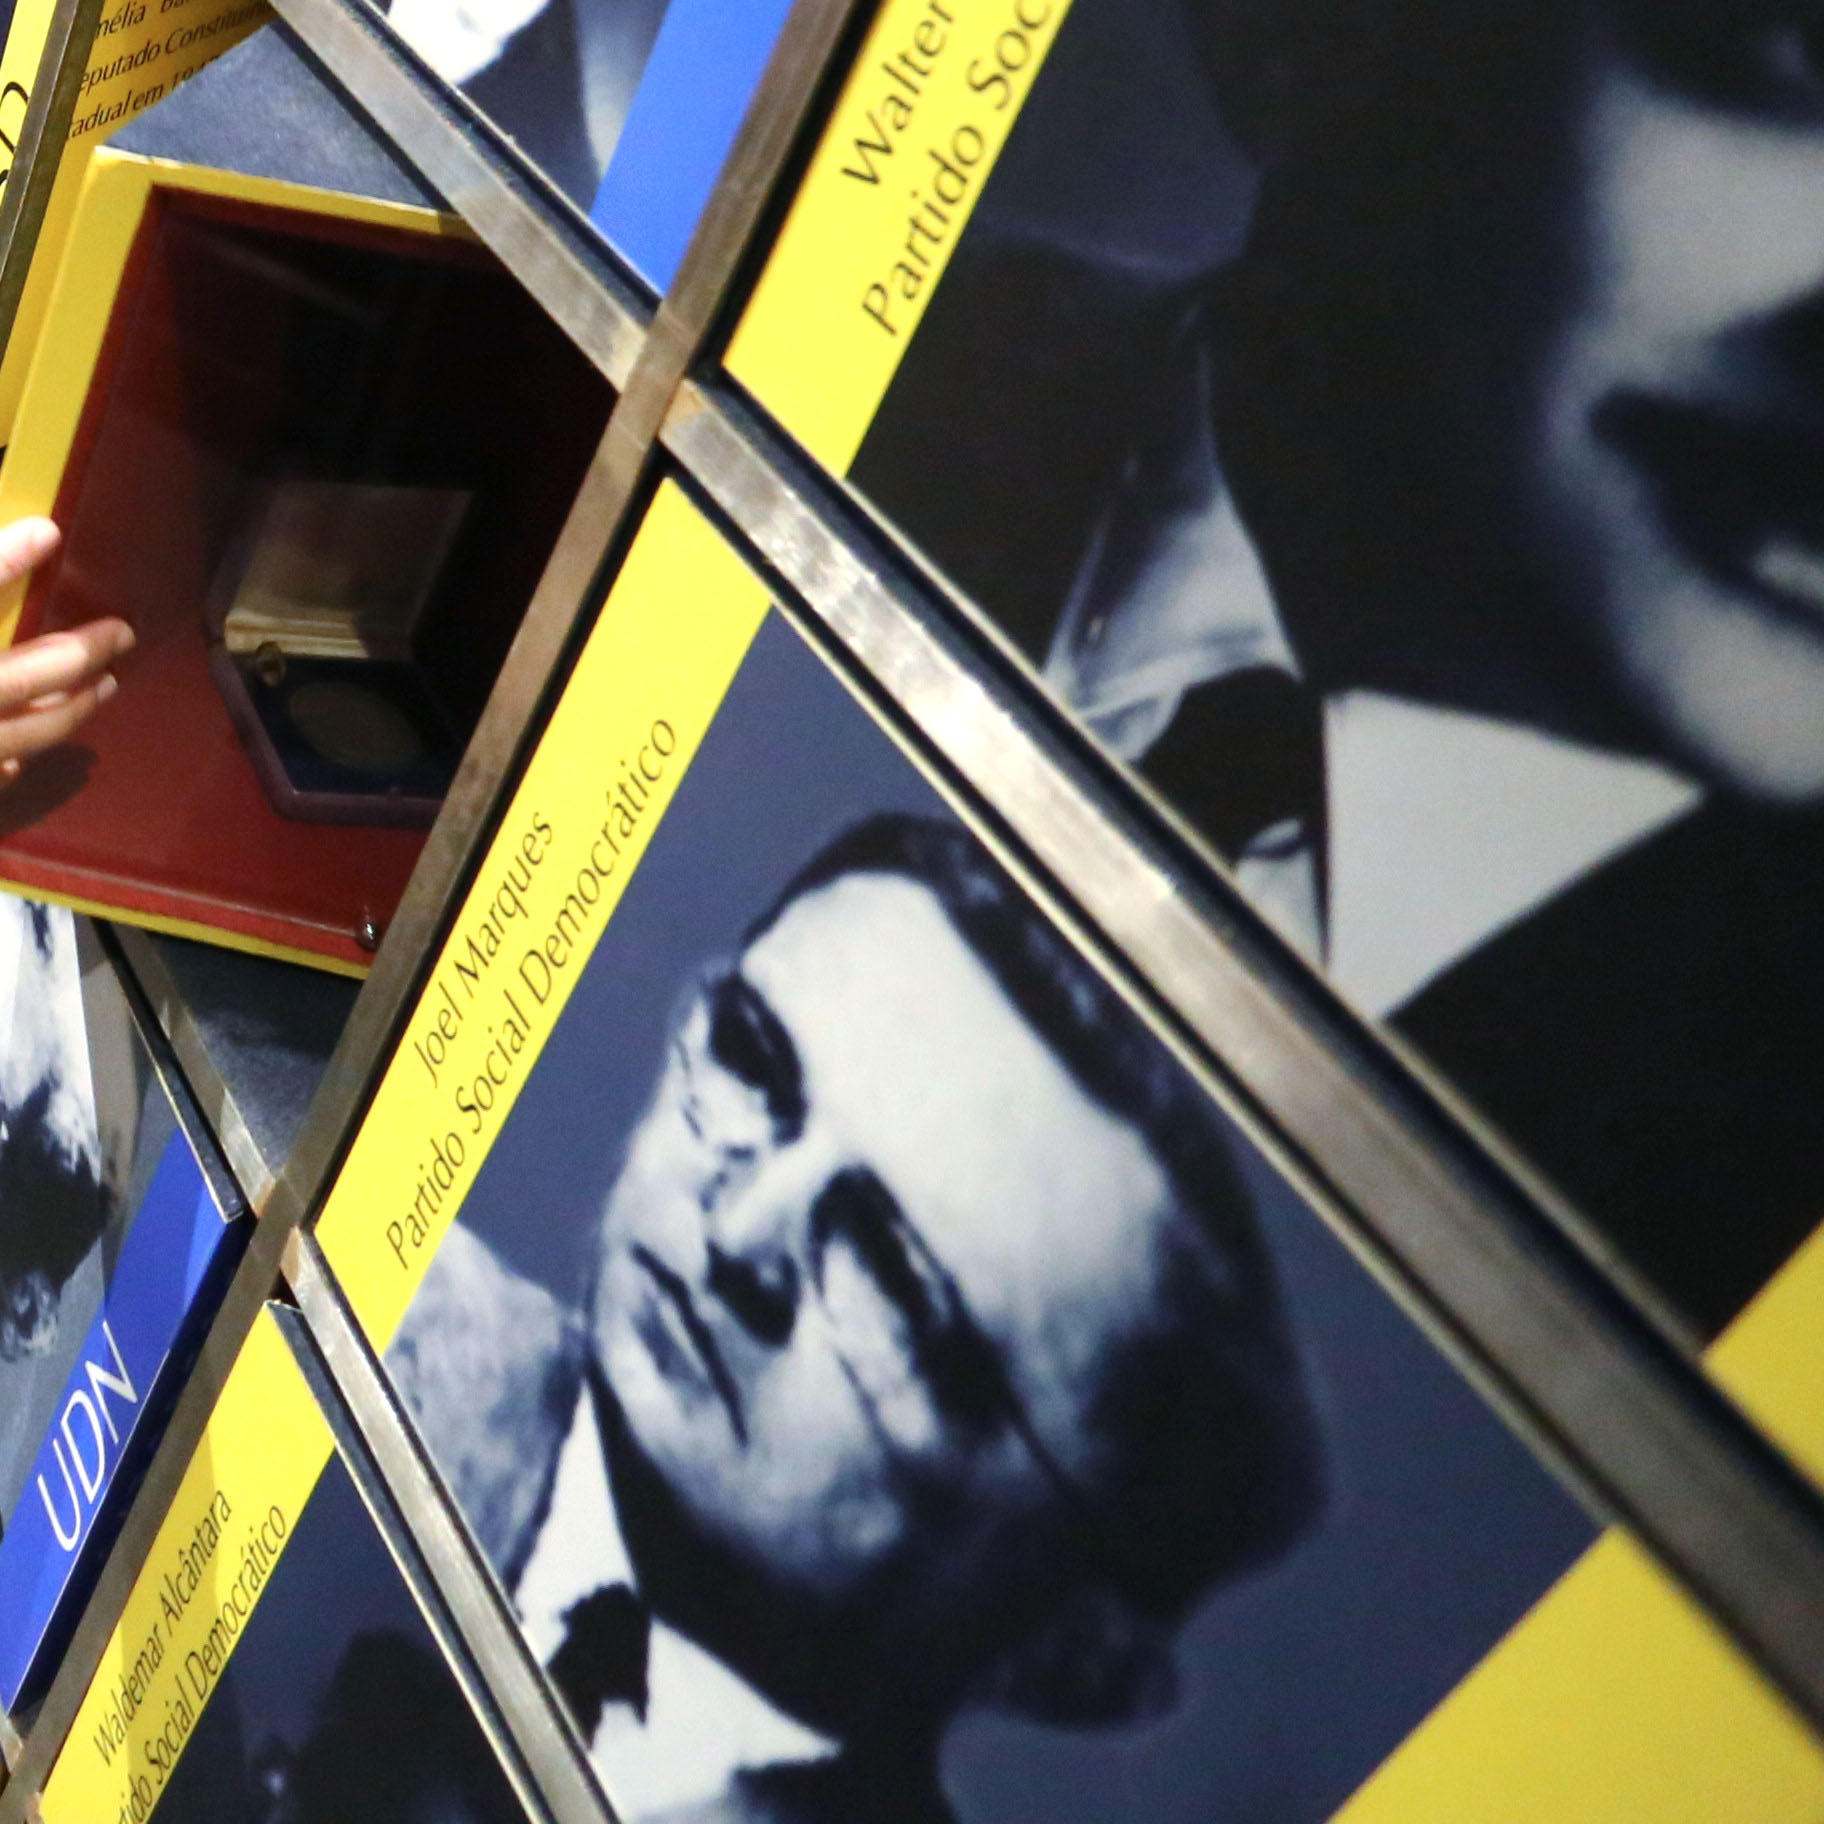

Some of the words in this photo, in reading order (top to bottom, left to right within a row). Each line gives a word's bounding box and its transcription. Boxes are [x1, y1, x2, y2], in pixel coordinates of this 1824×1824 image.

[132, 83, 164, 111] em
[860, 122, 988, 339] Partido
[386, 1122, 467, 1272] Partido
[458, 979, 523, 1135] Social
[510, 717, 678, 1008] Democrático
[420, 998, 464, 1092] Joel
[461, 809, 555, 1002] Marques
[38, 1320, 140, 1553] UDN
[94, 1622, 166, 1767] Waldemar
[159, 1487, 234, 1638] Alcântara
[144, 1674, 194, 1782] Social
[185, 1505, 288, 1703] Democrático
